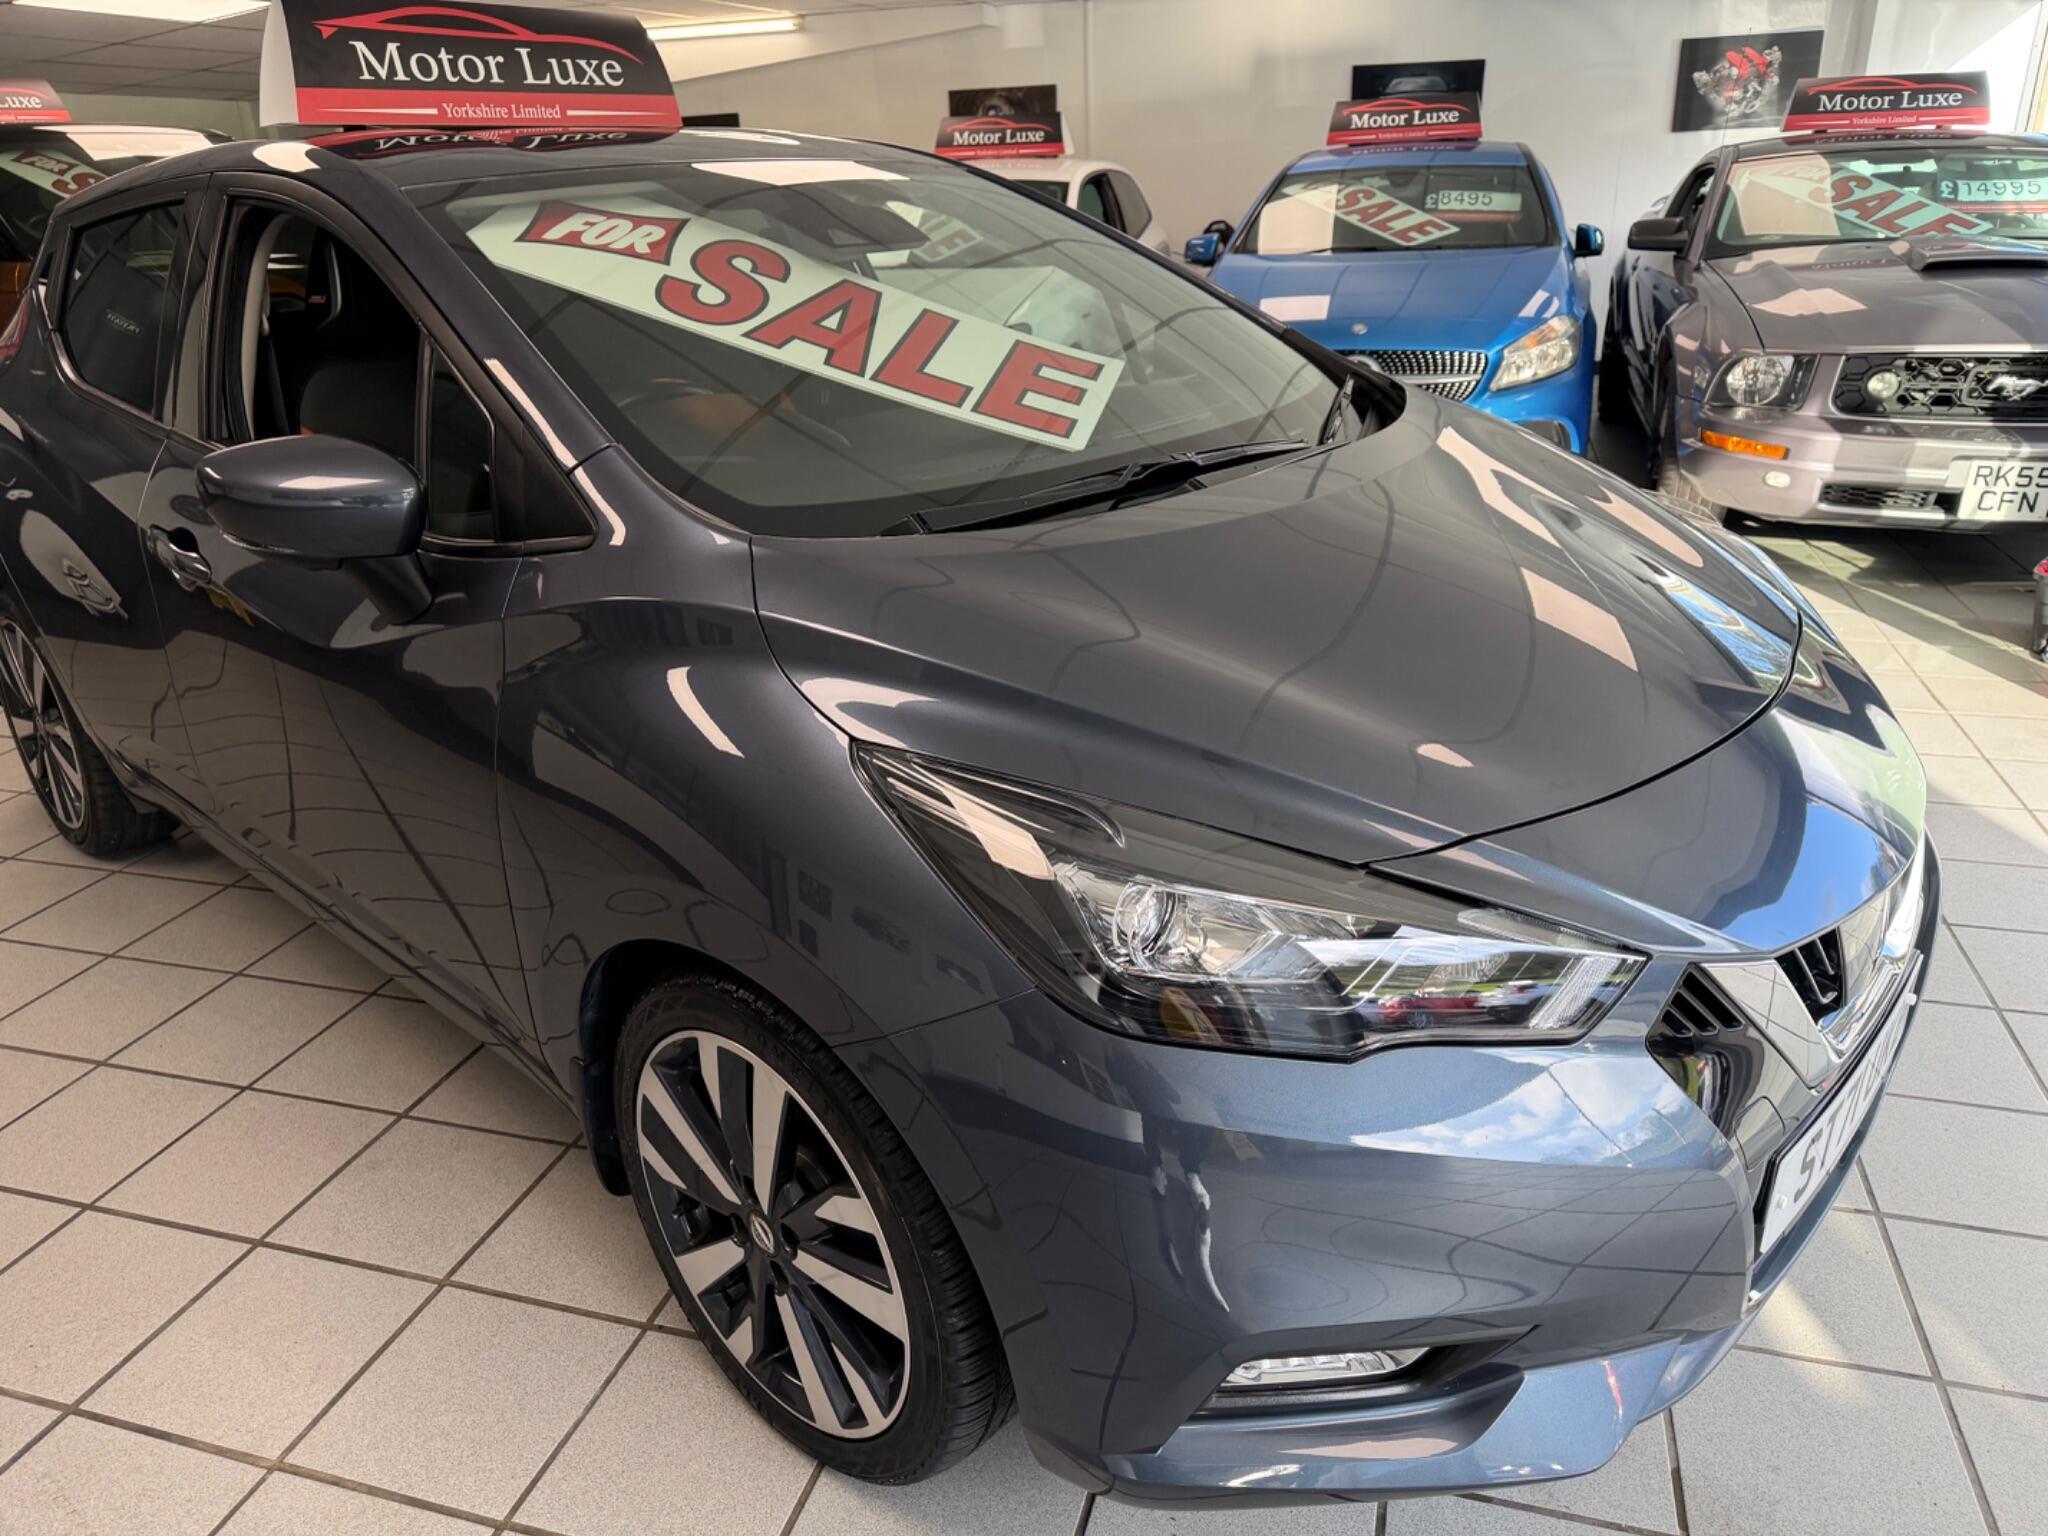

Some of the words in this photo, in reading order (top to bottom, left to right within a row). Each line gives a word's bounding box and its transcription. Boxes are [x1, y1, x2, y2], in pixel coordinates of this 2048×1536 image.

[348, 40, 505, 84] Motor
[514, 47, 625, 88] Luxe
[442, 102, 509, 120] Yorkshire
[511, 104, 562, 120] Limited
[1816, 93, 1894, 112] Motor
[1900, 90, 1964, 109] Luxe
[1350, 113, 1408, 129] Motor
[1412, 109, 1460, 125] Luxe
[952, 129, 1002, 147] Motor
[1005, 127, 1046, 144] Luxe
[1424, 191, 1493, 209] £8495
[1940, 180, 2042, 199] £14995
[1337, 186, 1449, 244] SALE
[1808, 174, 1981, 236] SALE
[541, 211, 666, 254] FOR
[655, 239, 1106, 439] SALE
[1977, 490, 2040, 513] CFN
